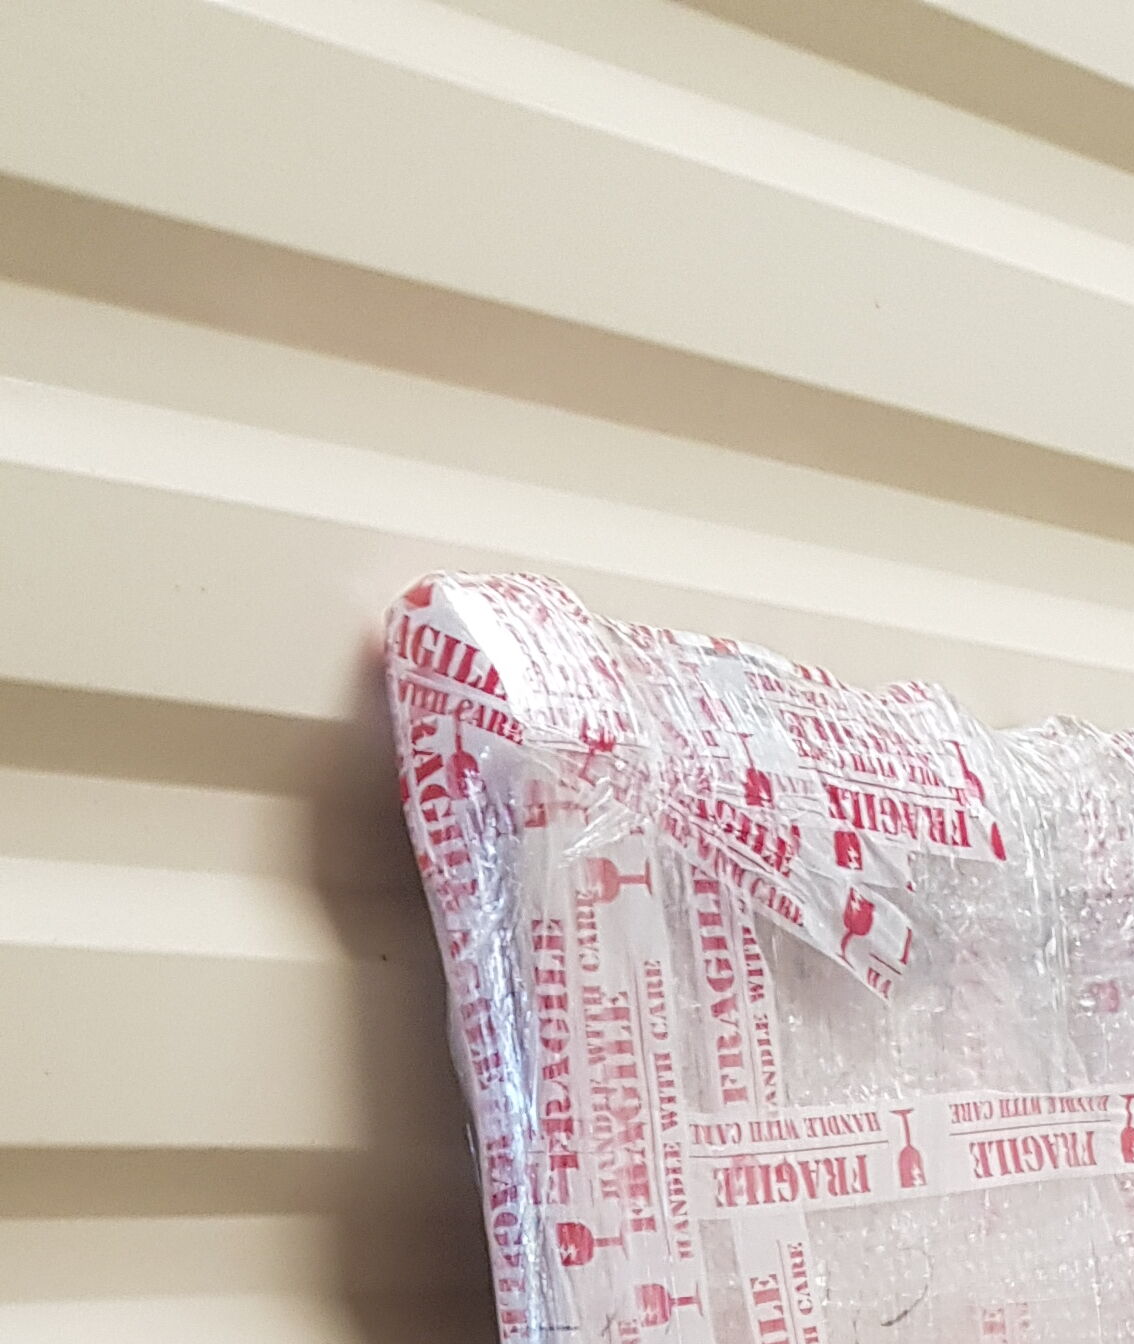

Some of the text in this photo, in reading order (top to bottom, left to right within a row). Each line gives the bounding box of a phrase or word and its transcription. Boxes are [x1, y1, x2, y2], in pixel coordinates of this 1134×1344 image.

[826, 784, 972, 848] FRAGILE
[531, 919, 579, 1169] FRAGILE
[644, 960, 694, 1260] HANDLE WITH CARE
[749, 1111, 881, 1143] HANDLE WITH
[950, 1103, 995, 1124] CARE
[999, 1097, 1045, 1118] WITH
[969, 1130, 1098, 1179] FRAGILE
[713, 1155, 872, 1209] FRAGILE
[787, 1242, 812, 1315] CARE
